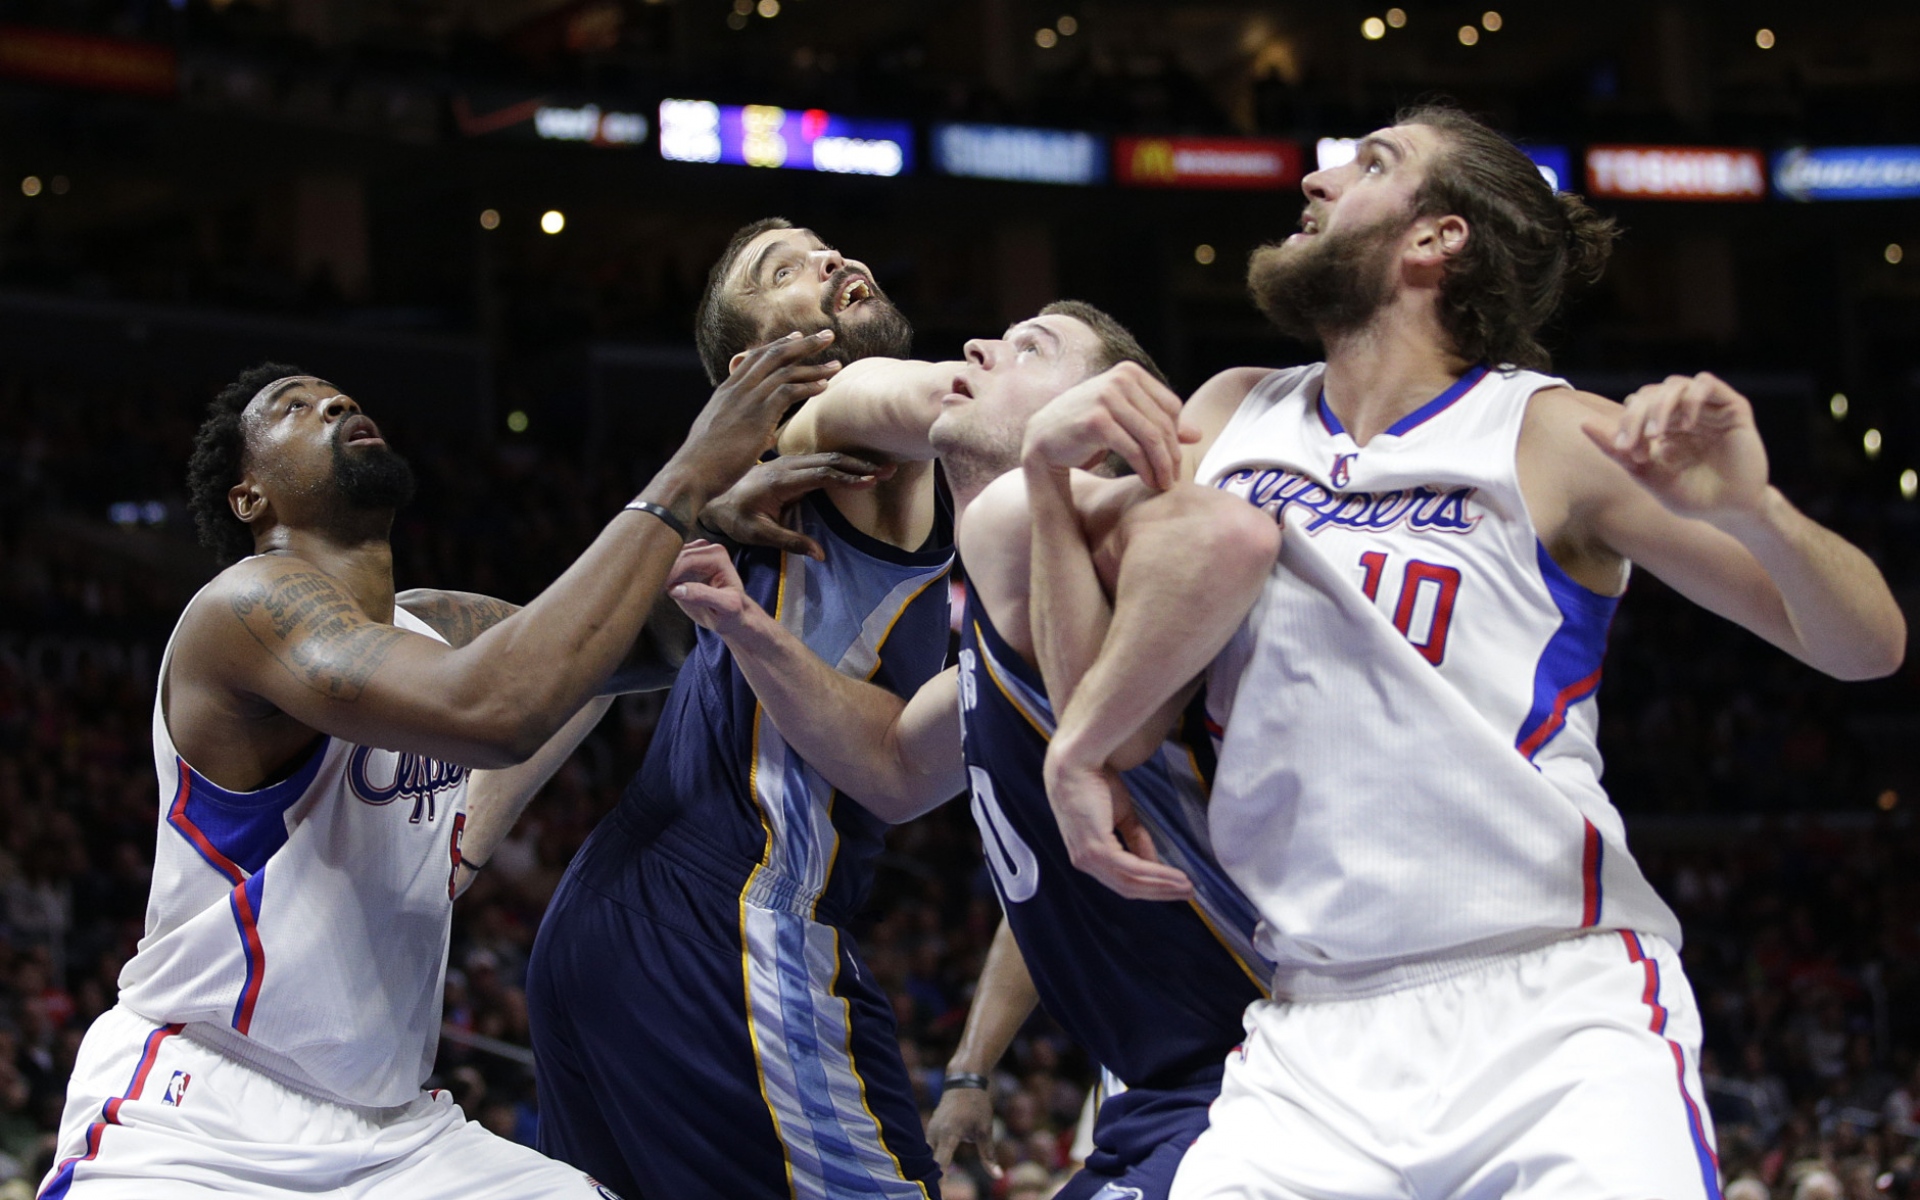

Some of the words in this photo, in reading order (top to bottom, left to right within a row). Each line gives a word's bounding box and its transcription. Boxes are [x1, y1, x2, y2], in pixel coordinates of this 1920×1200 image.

[1587, 147, 1764, 195] TOSHIBA
[1358, 550, 1462, 668] 10
[347, 743, 471, 824] Clippe
[968, 764, 1040, 904] 0
